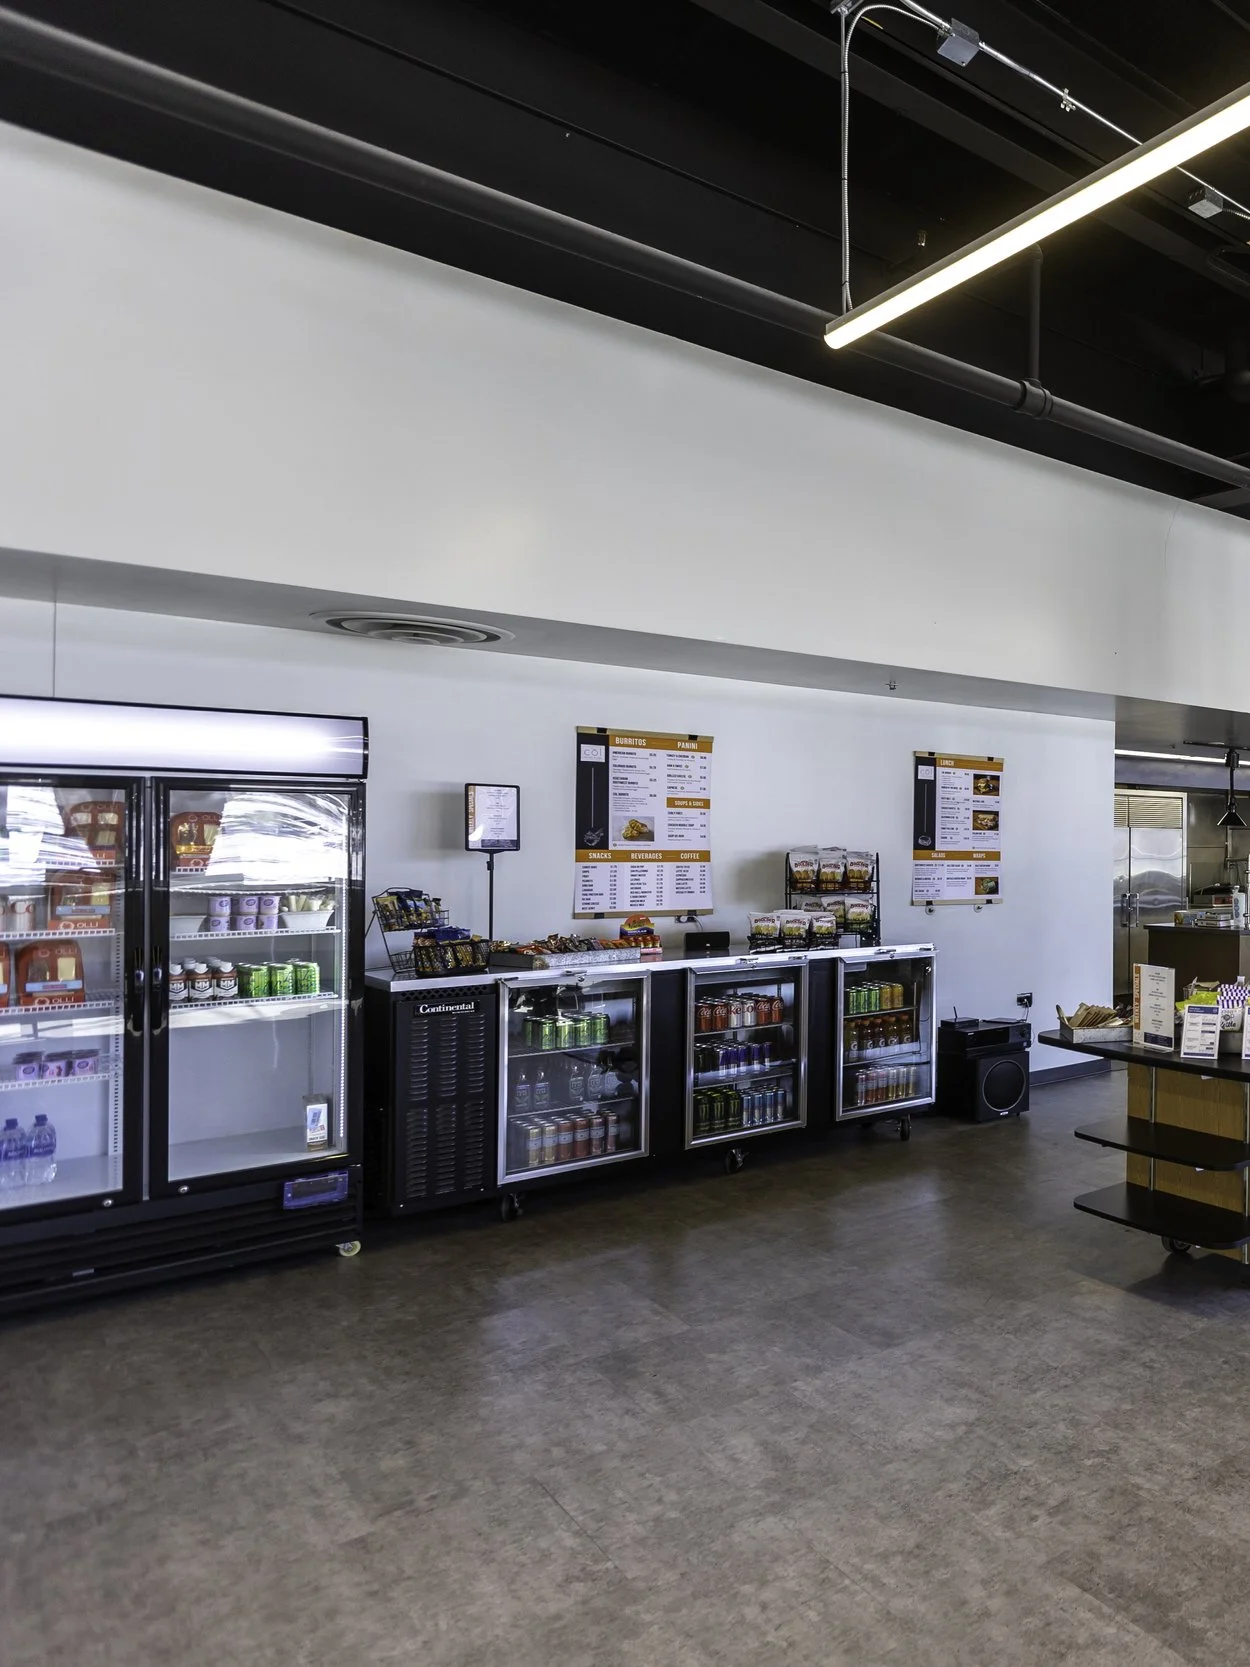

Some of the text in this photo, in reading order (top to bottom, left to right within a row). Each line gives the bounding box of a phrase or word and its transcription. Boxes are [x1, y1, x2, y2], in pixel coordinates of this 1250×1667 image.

[615, 736, 698, 750] BURRITOS PANINI
[76, 921, 99, 929] OLLI
[420, 1002, 475, 1014] Continental
